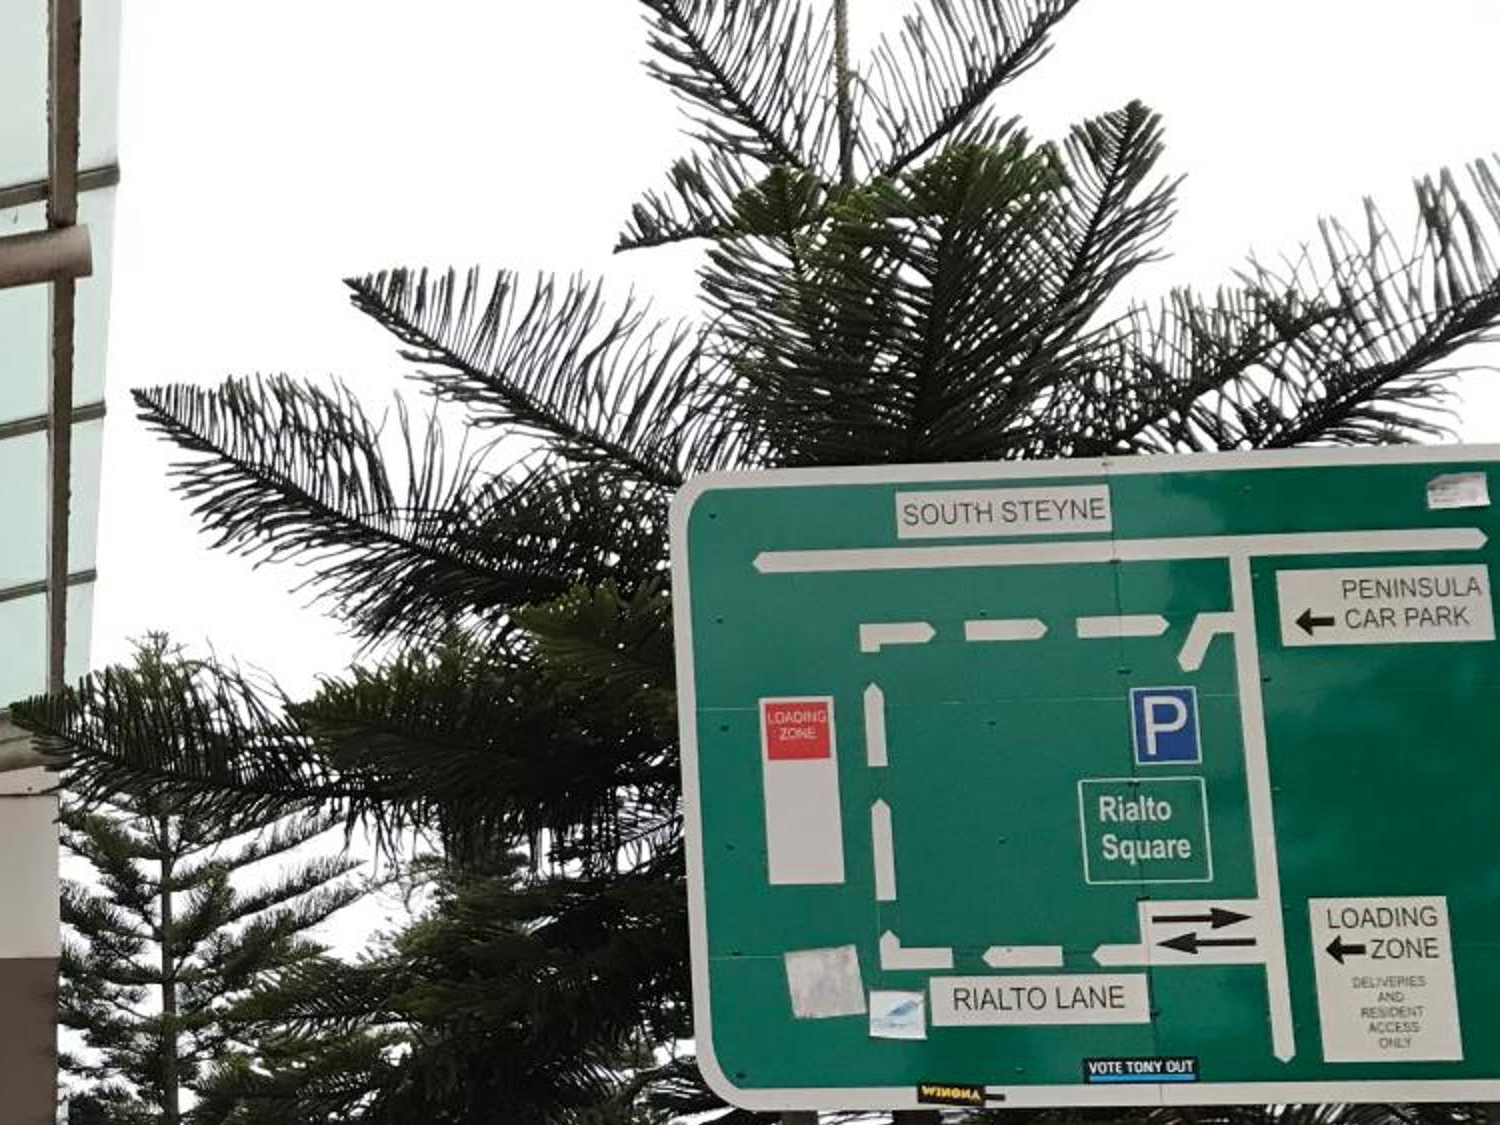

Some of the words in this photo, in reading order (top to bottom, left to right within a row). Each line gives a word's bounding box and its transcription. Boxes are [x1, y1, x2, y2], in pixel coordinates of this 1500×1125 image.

[902, 501, 994, 527] SOUTH
[1001, 497, 1106, 523] STEYNE
[1341, 576, 1483, 600] PENINSULA
[1344, 607, 1396, 630] CAR
[1404, 605, 1471, 627] PARK
[767, 709, 827, 725] LOADING
[1143, 695, 1188, 756] P
[779, 726, 818, 741] ZONE
[1099, 795, 1173, 823] Rialto
[1102, 833, 1193, 866] Square
[1326, 905, 1438, 930] LOADING
[1370, 937, 1440, 960] ZONE
[1351, 975, 1426, 989] DELIVERIES
[952, 986, 1047, 1011] RIALTO
[1055, 984, 1125, 1009] LANE
[1377, 990, 1405, 1003] AND
[1361, 1005, 1424, 1019] RESIDENT
[1368, 1020, 1421, 1033] ACCESS
[1378, 1037, 1412, 1049] ONLY
[1089, 1061, 1122, 1074] VOTE
[1125, 1060, 1162, 1073] TONY
[1165, 1059, 1195, 1073] OUT
